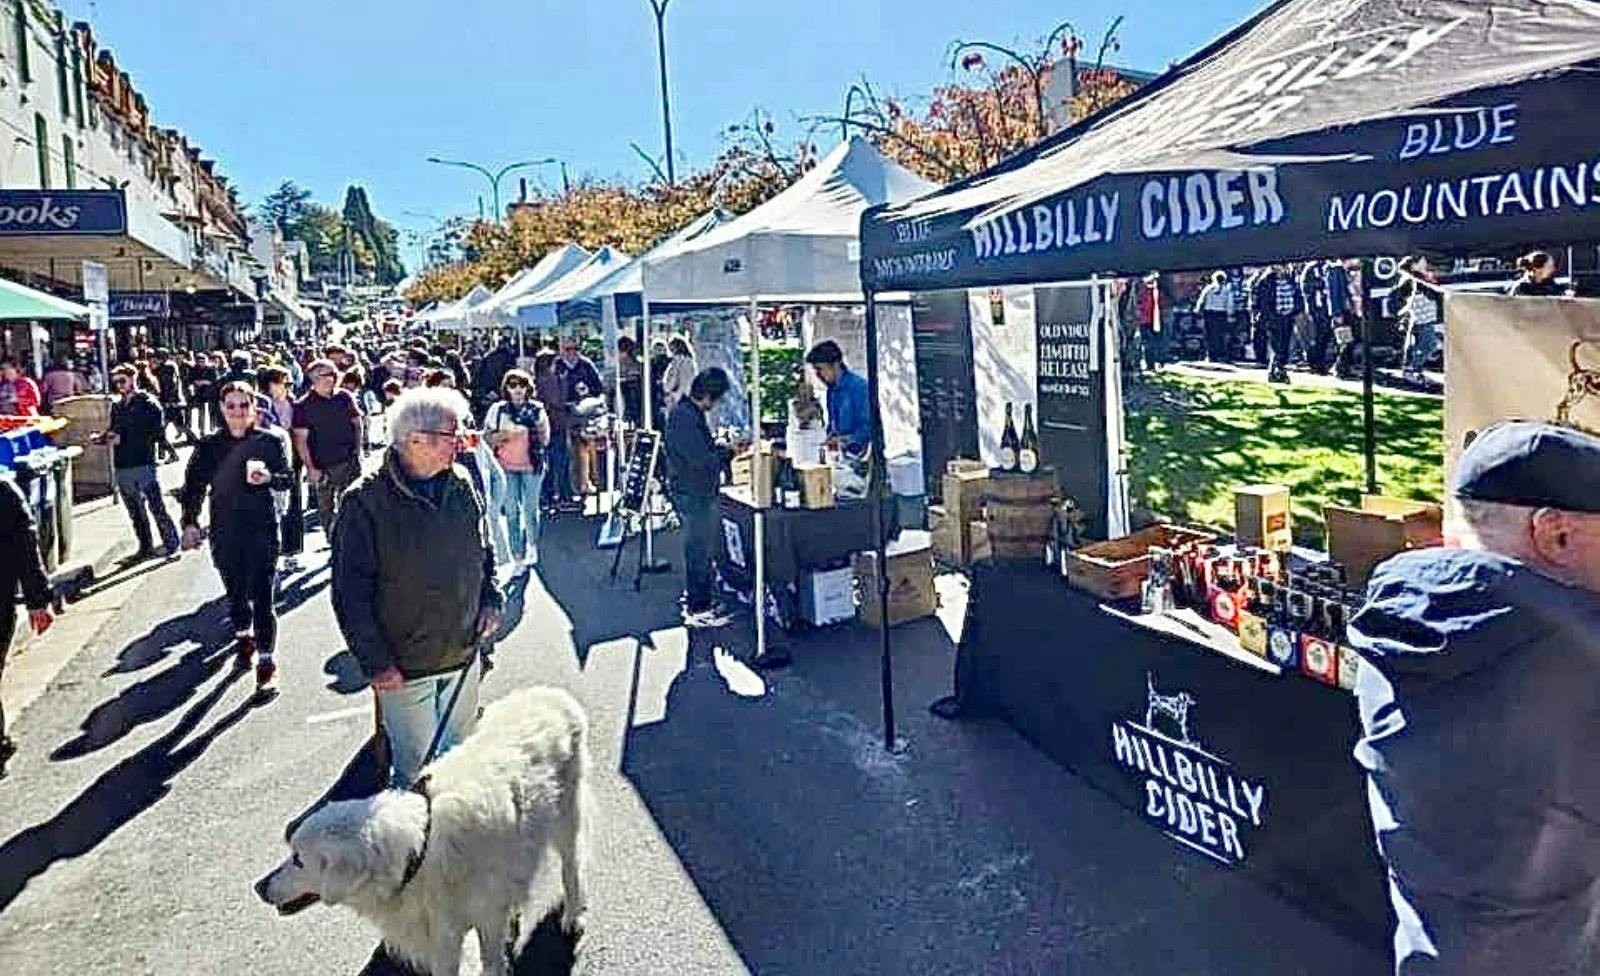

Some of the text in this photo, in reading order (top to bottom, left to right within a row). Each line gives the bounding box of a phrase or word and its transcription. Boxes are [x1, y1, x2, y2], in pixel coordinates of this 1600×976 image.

[1400, 103, 1517, 159] BLUE
[972, 168, 1284, 258] HILLBILLY CIDER
[1040, 361, 1090, 379] RELEASE
[1112, 722, 1264, 827] HILLBILLY
[1146, 779, 1245, 860] CIDER
